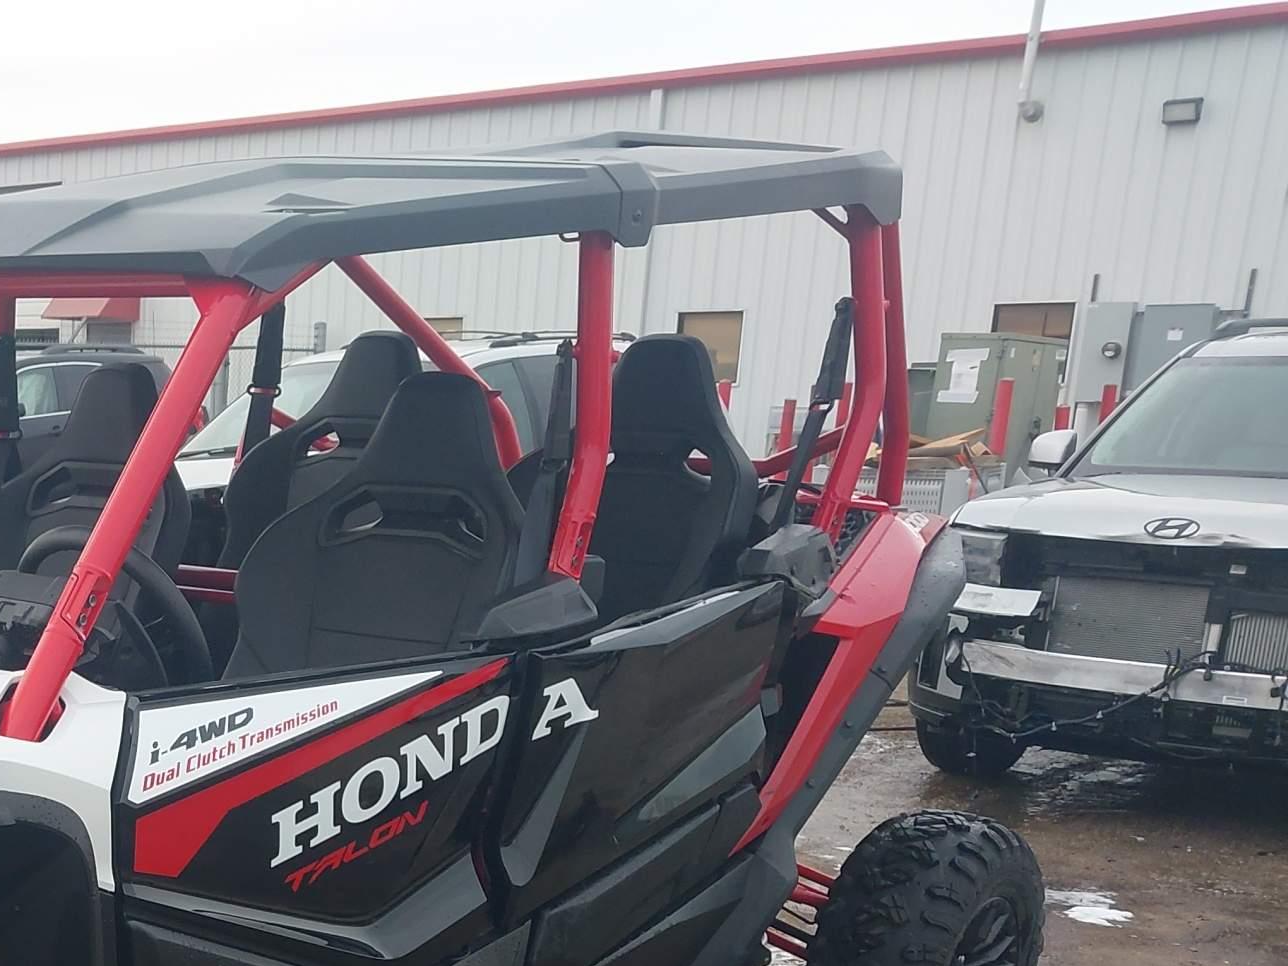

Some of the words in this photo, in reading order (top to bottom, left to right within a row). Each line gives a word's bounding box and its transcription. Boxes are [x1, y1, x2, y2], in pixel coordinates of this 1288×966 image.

[142, 761, 180, 793] Dual
[185, 740, 236, 774] Clutch
[238, 699, 339, 751] Transmission
[149, 706, 254, 766] i-4WD
[269, 677, 600, 869] HONDA
[284, 799, 429, 893] TALON
